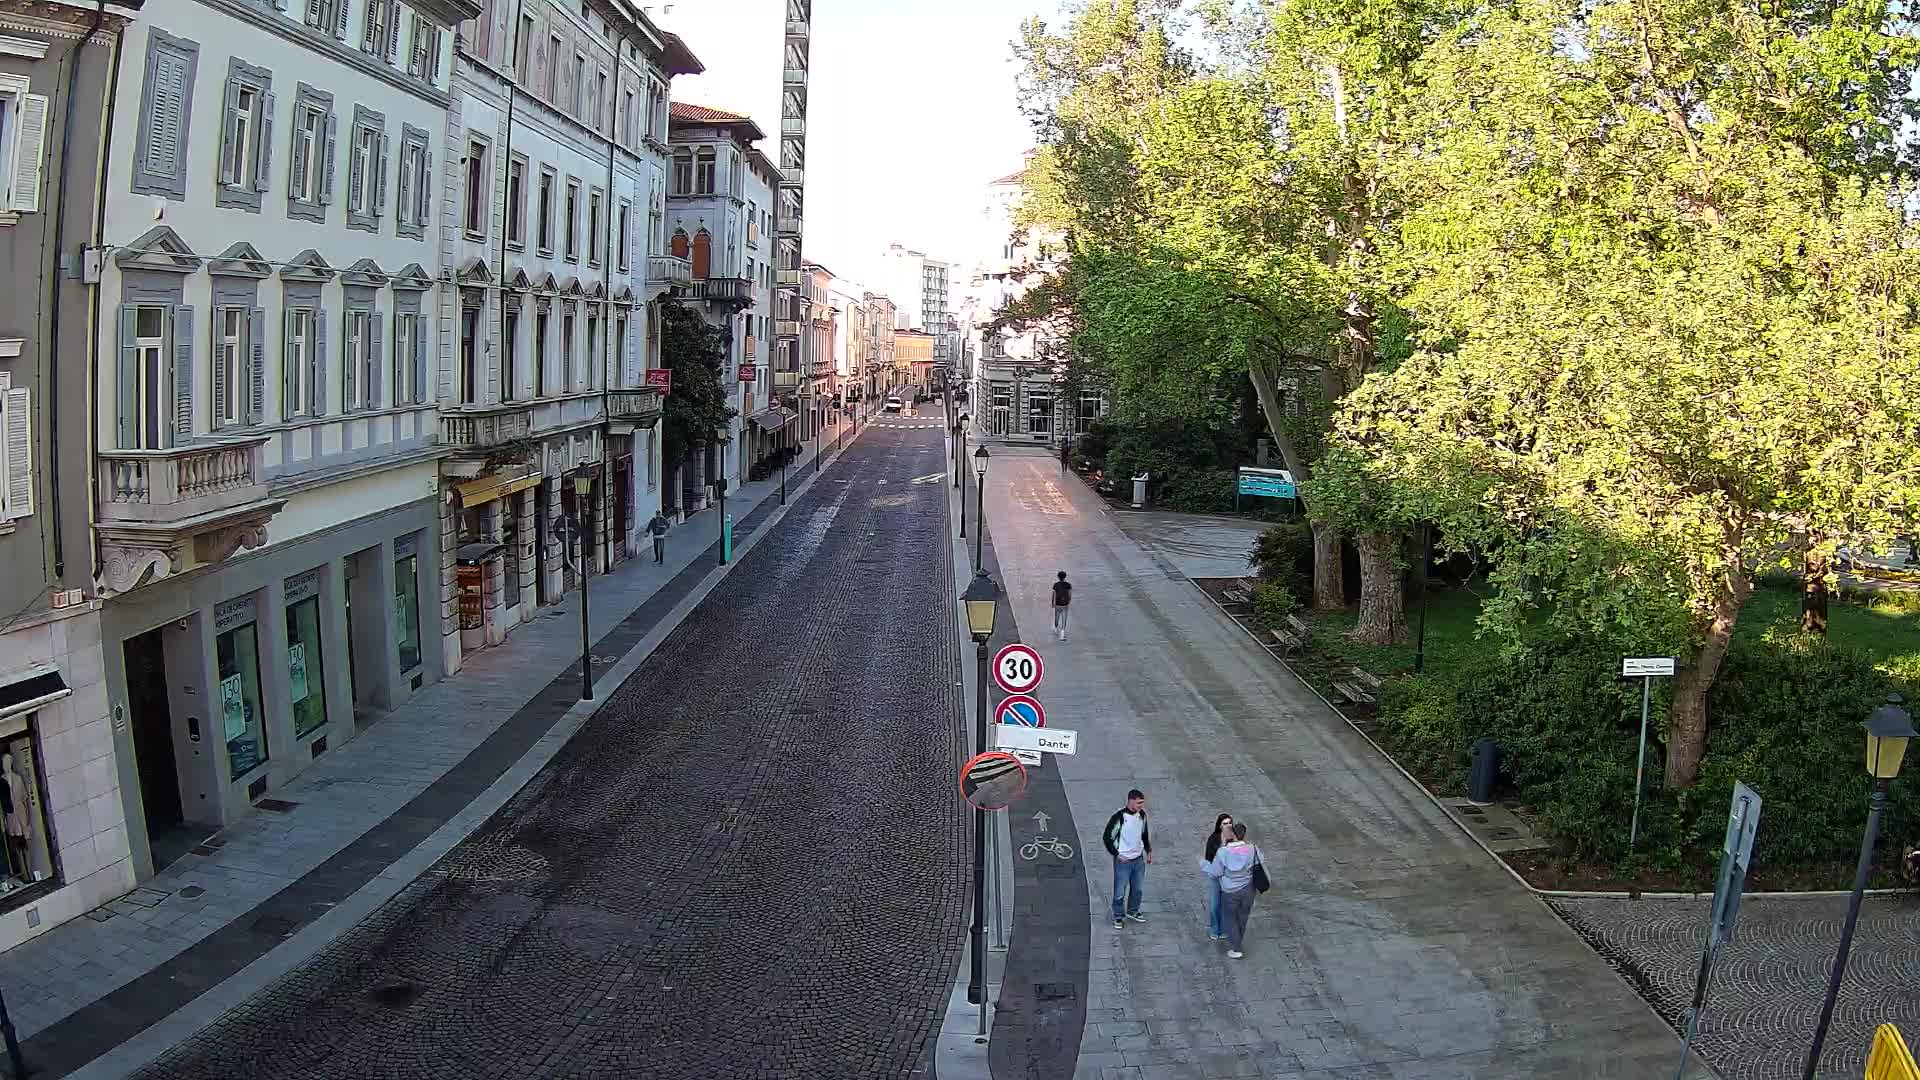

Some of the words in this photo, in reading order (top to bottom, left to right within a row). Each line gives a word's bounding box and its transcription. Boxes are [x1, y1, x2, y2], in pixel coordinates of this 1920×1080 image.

[1005, 658, 1033, 680] 30
[221, 678, 240, 701] 130
[1038, 738, 1070, 749] Dante
